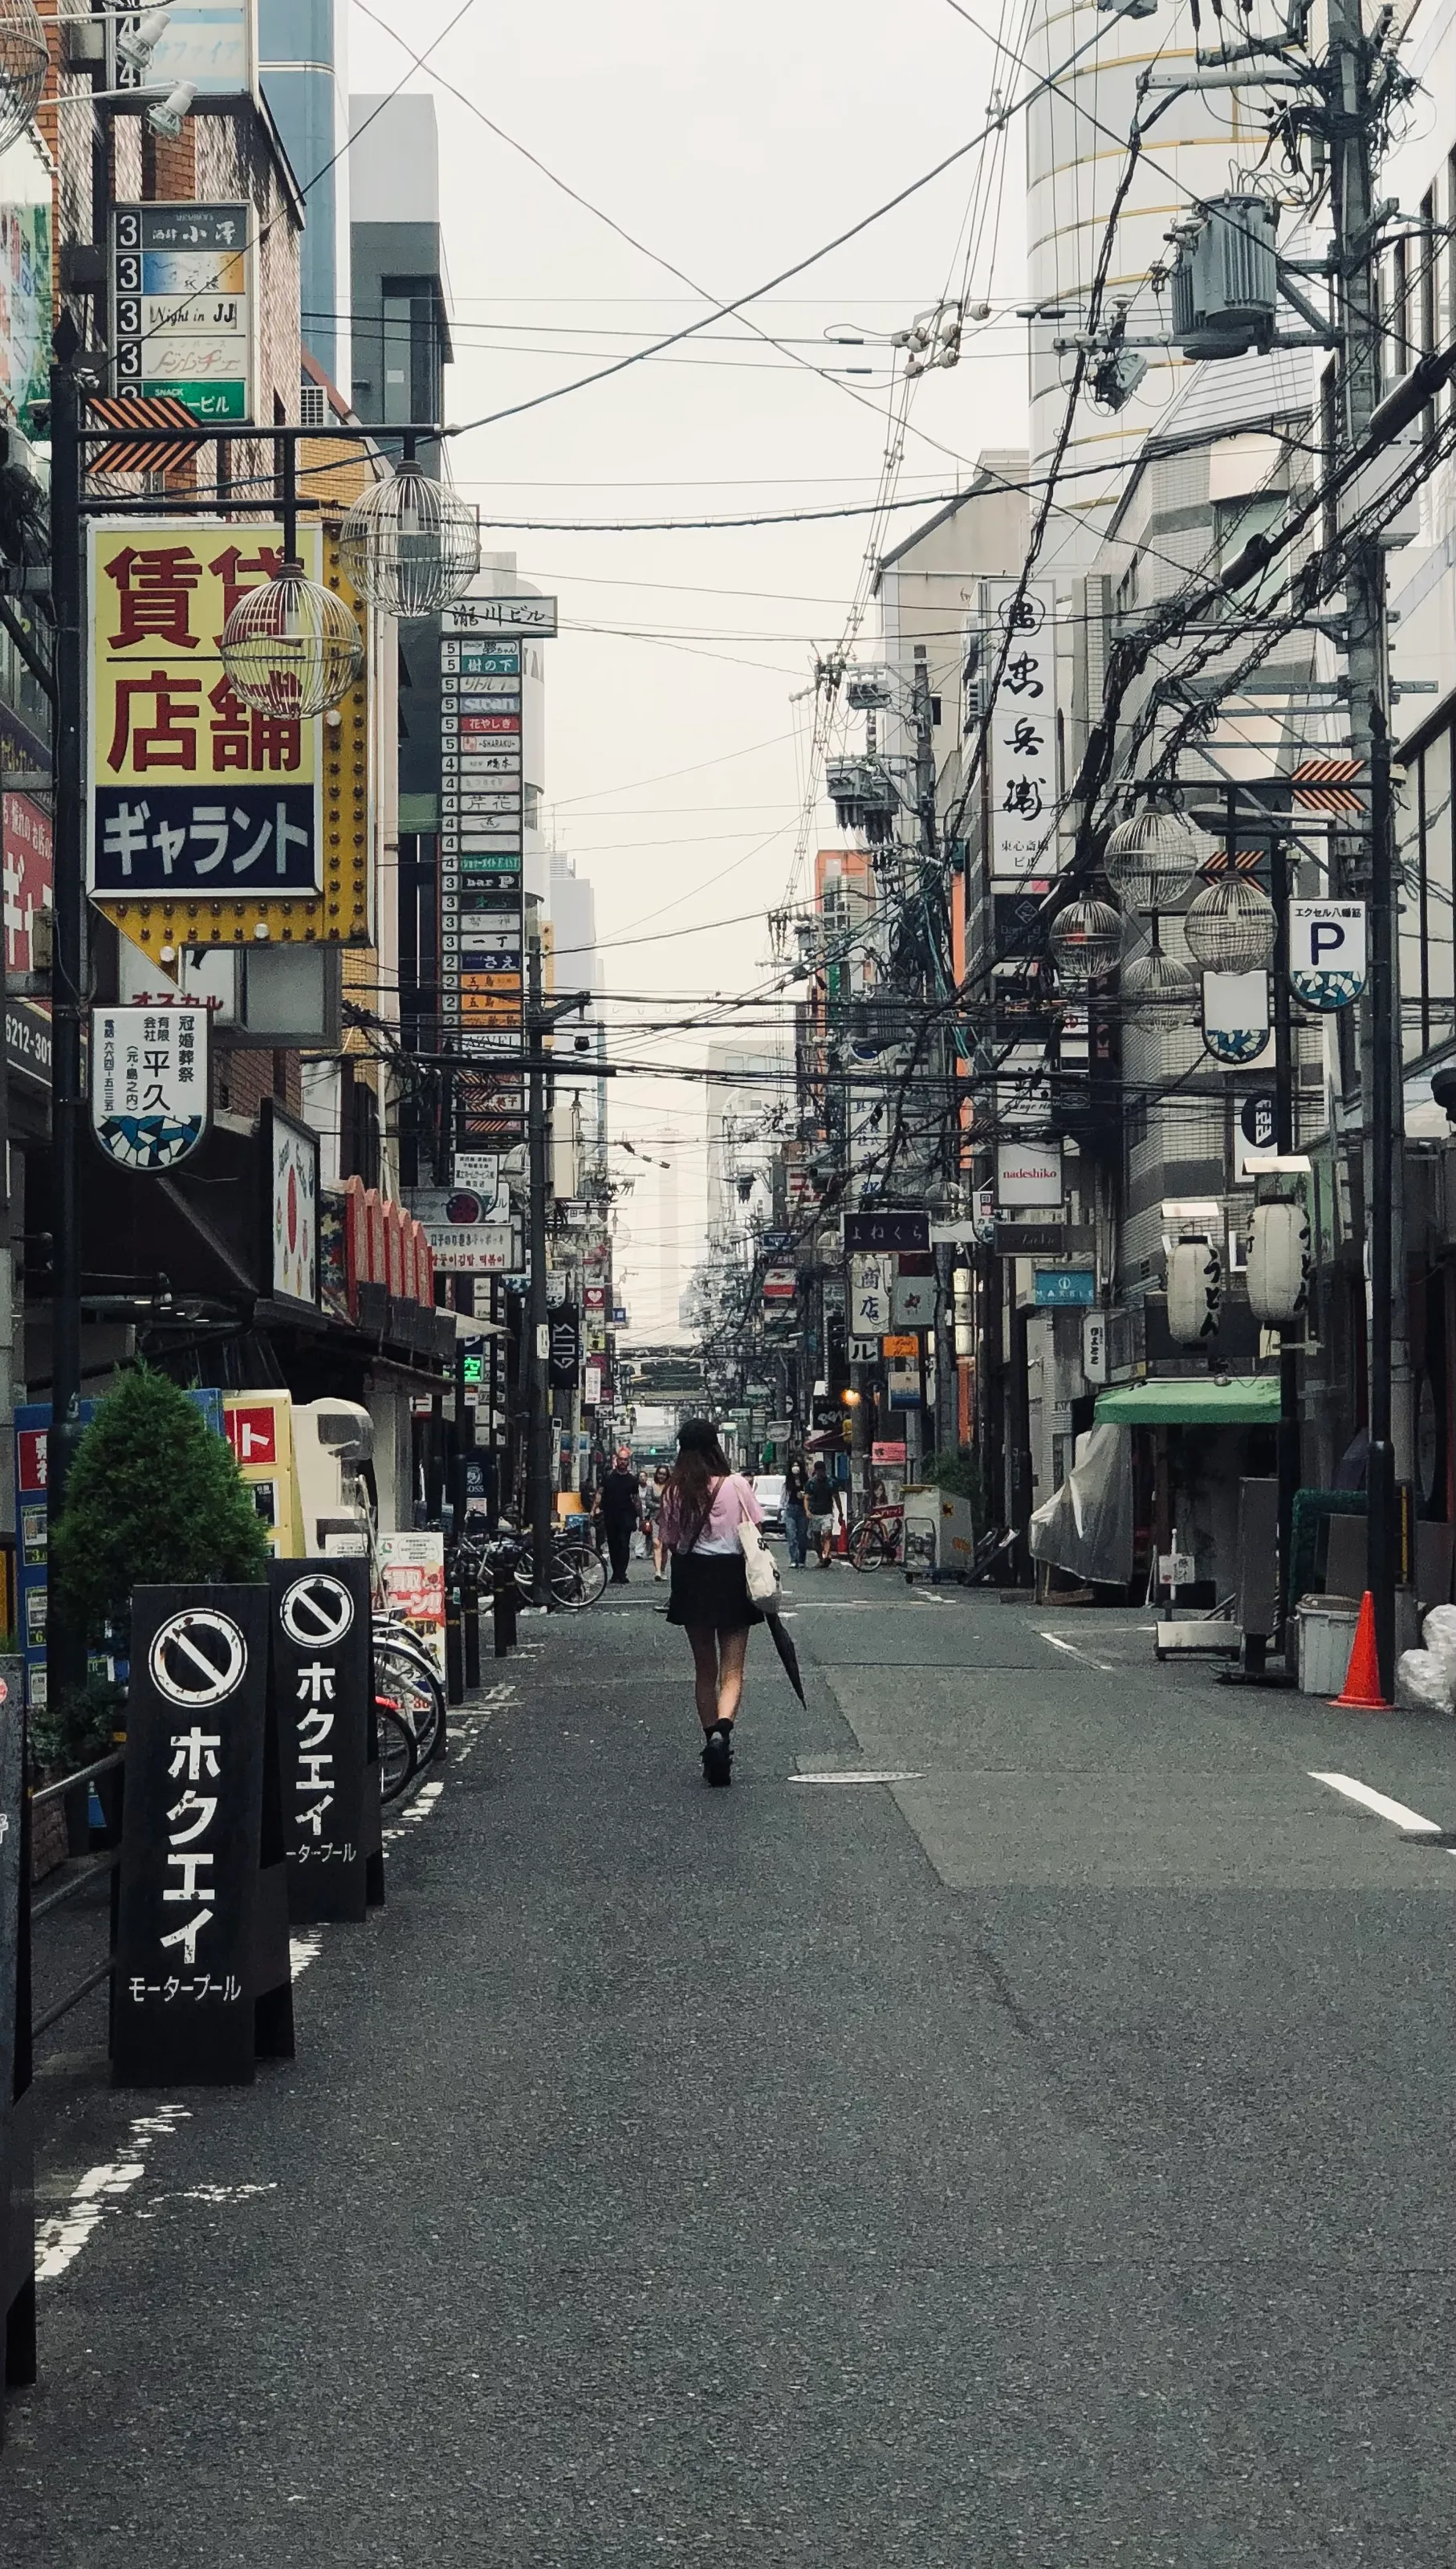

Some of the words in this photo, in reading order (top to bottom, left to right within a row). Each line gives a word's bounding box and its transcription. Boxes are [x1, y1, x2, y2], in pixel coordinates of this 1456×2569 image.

[120, 215, 136, 246] 3
[120, 258, 138, 289] 3
[120, 300, 138, 332] 3
[120, 343, 139, 374] 3
[447, 642, 455, 654] 5
[447, 659, 456, 671] 5
[445, 679, 454, 690] 5
[445, 698, 454, 710] 5
[105, 670, 303, 774] 店舗
[445, 719, 454, 730] 5
[445, 739, 455, 750] 5
[445, 757, 455, 770] 4
[445, 777, 455, 788] 4
[445, 797, 455, 809] 4
[445, 818, 455, 829] 4
[103, 800, 308, 877] ギャラント
[445, 837, 455, 849] 4
[445, 857, 455, 869] 4
[445, 877, 455, 889] 3
[445, 897, 455, 908] 3
[445, 917, 455, 928] 3
[445, 936, 455, 948] 3
[1310, 921, 1345, 966] P
[445, 956, 455, 968] 2
[445, 995, 455, 1008] 2
[177, 1016, 195, 1083] 冠婚葬祭
[1003, 1168, 1057, 1179] nadeshiko
[552, 1323, 575, 1369] GUTS
[295, 1661, 336, 1836] ホクエイ
[160, 1725, 222, 1964] ホクエイ
[128, 1973, 241, 2003] モータープール
